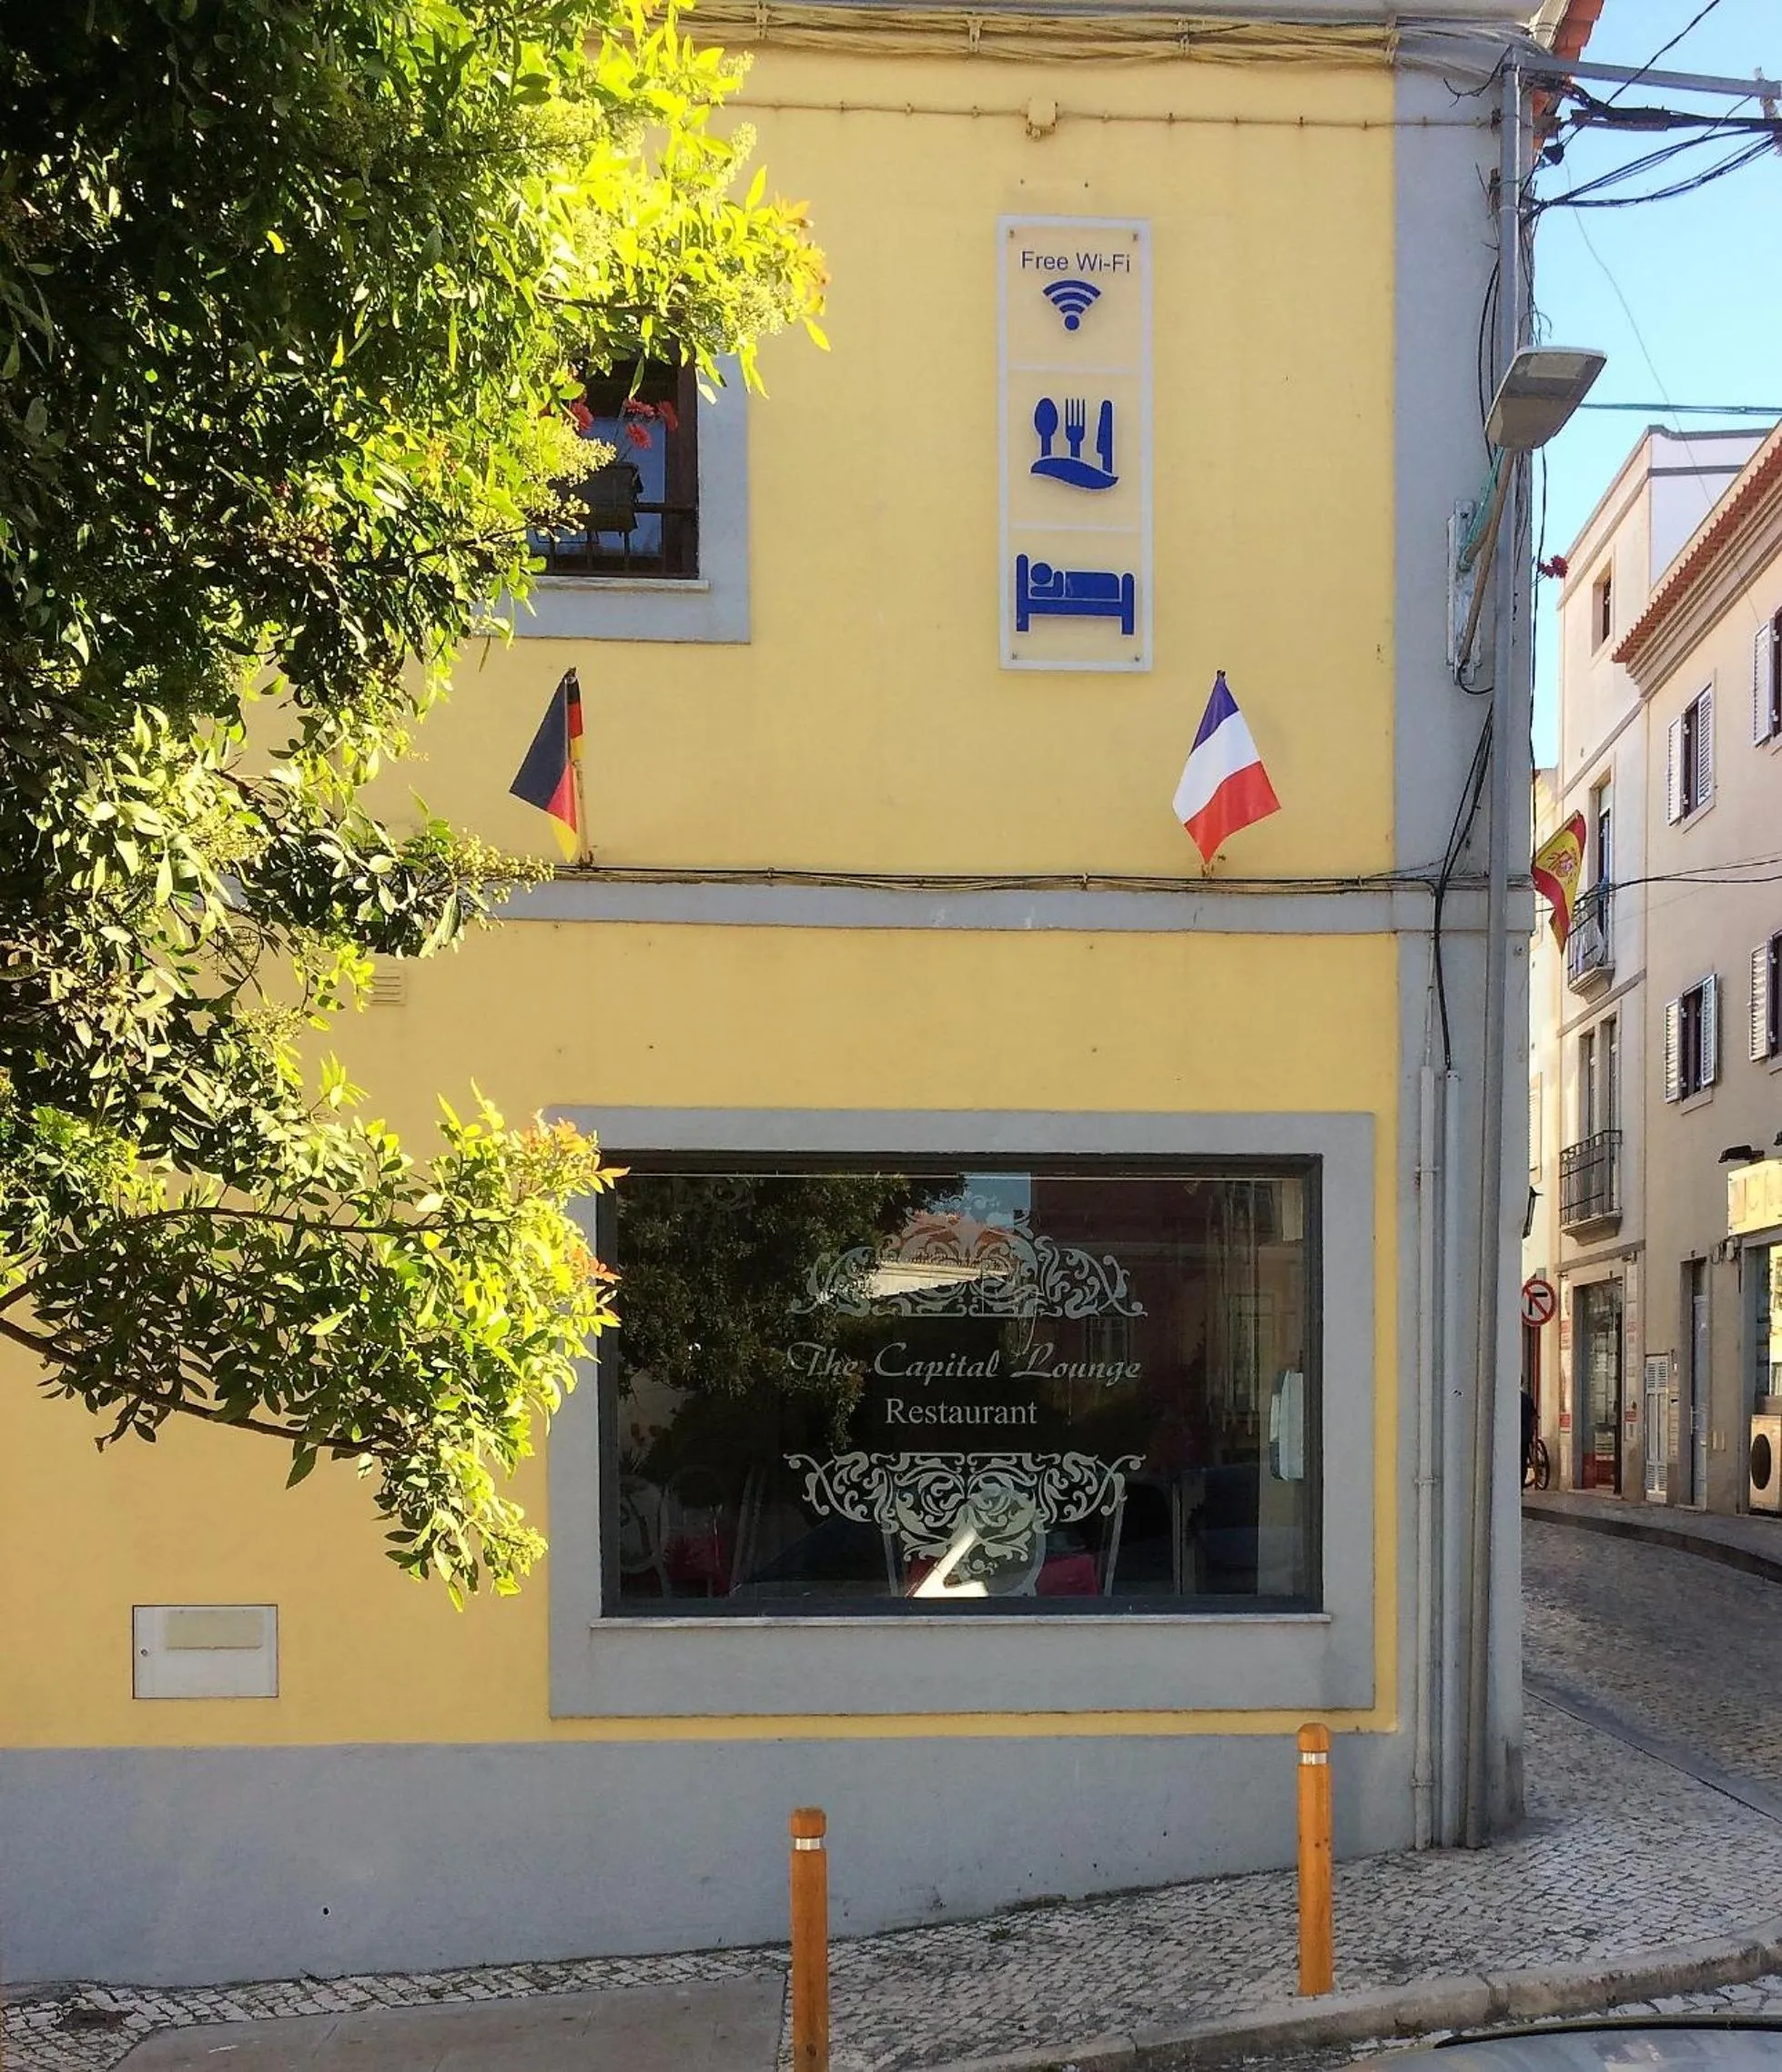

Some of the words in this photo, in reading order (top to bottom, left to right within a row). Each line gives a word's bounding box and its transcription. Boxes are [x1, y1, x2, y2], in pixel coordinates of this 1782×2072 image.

[1021, 250, 1068, 270] Free
[1076, 252, 1130, 273] Wi-Fi
[786, 1341, 860, 1378] The
[874, 1341, 1000, 1386] Capital
[1010, 1342, 1141, 1387] Lounge
[886, 1398, 1038, 1425] Restaurant
